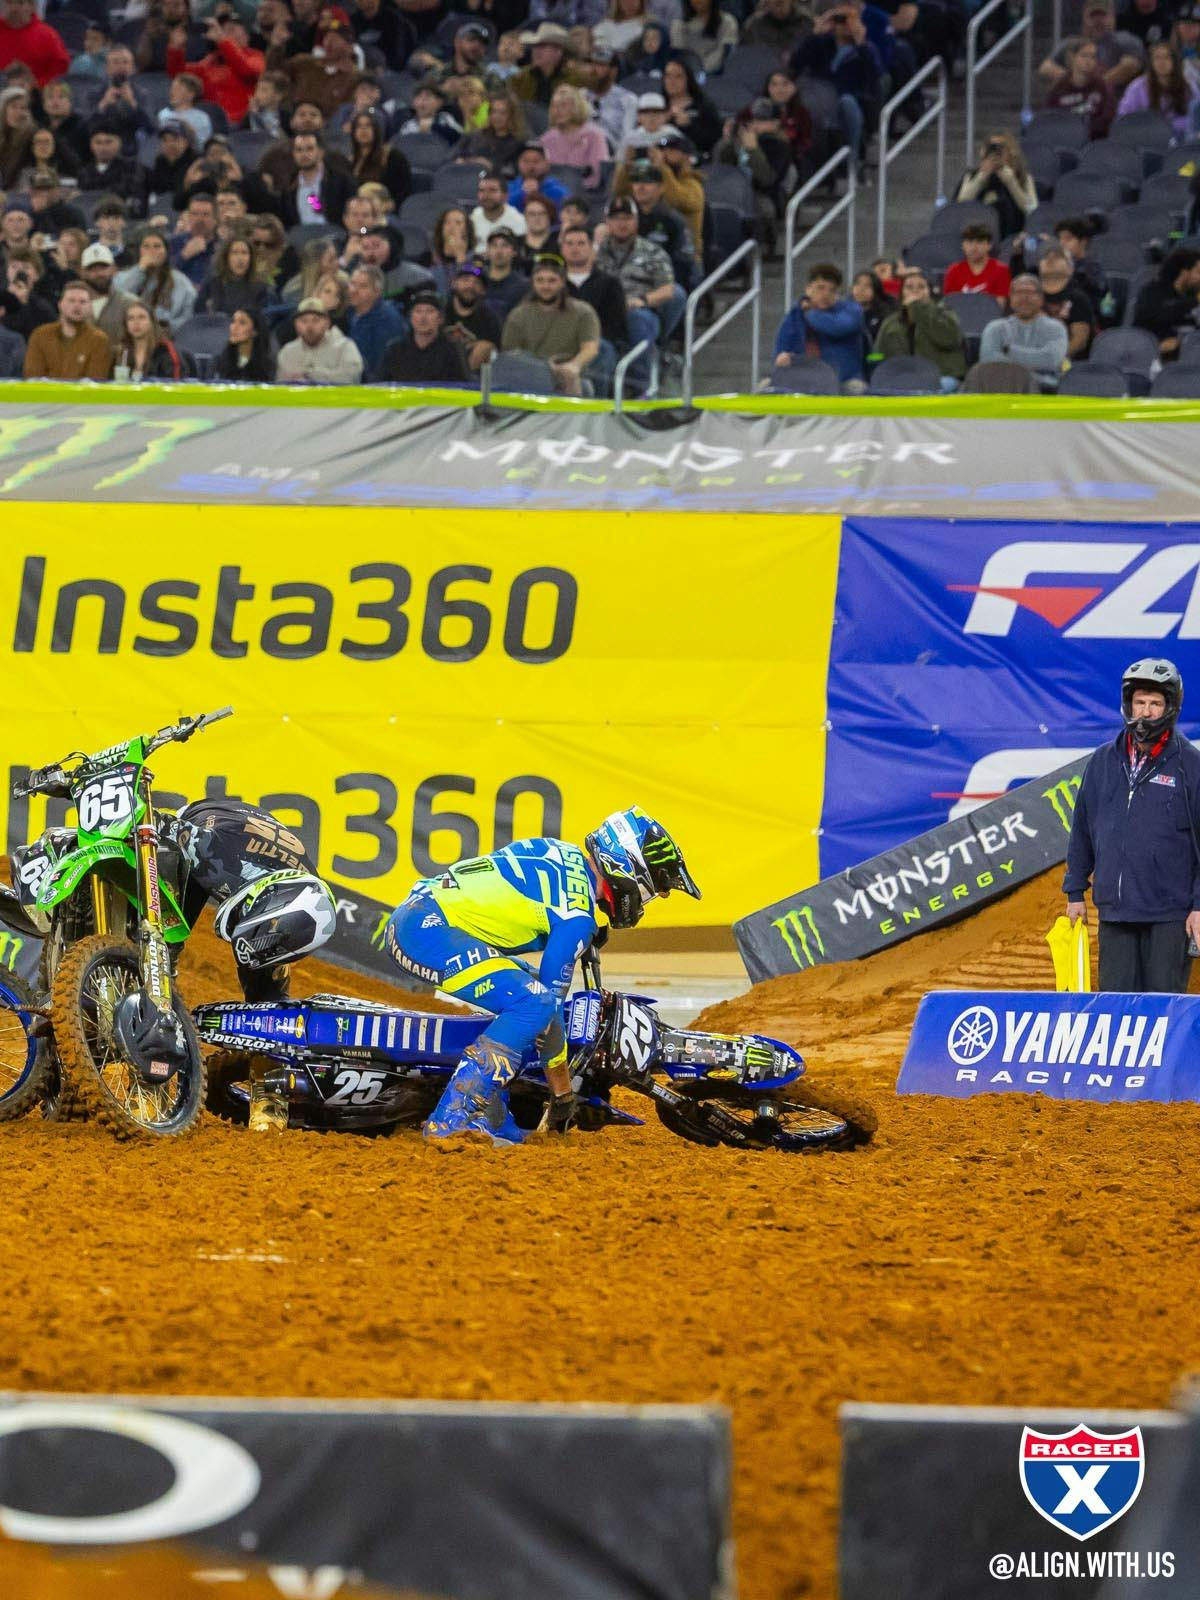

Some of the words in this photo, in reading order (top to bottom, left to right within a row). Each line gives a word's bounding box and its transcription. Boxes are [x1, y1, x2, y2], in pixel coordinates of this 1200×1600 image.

[13, 556, 579, 665] Insta360
[79, 773, 134, 832] 65
[832, 810, 1039, 924] MONSTER
[879, 859, 1016, 936] ENERGY
[391, 949, 439, 984] YAMAHA
[212, 1033, 276, 1051] DUNLOP
[620, 999, 653, 1072] 25
[1001, 1010, 1170, 1068] YAMAHA
[324, 1070, 388, 1106] 25
[955, 1069, 1147, 1089] RACING
